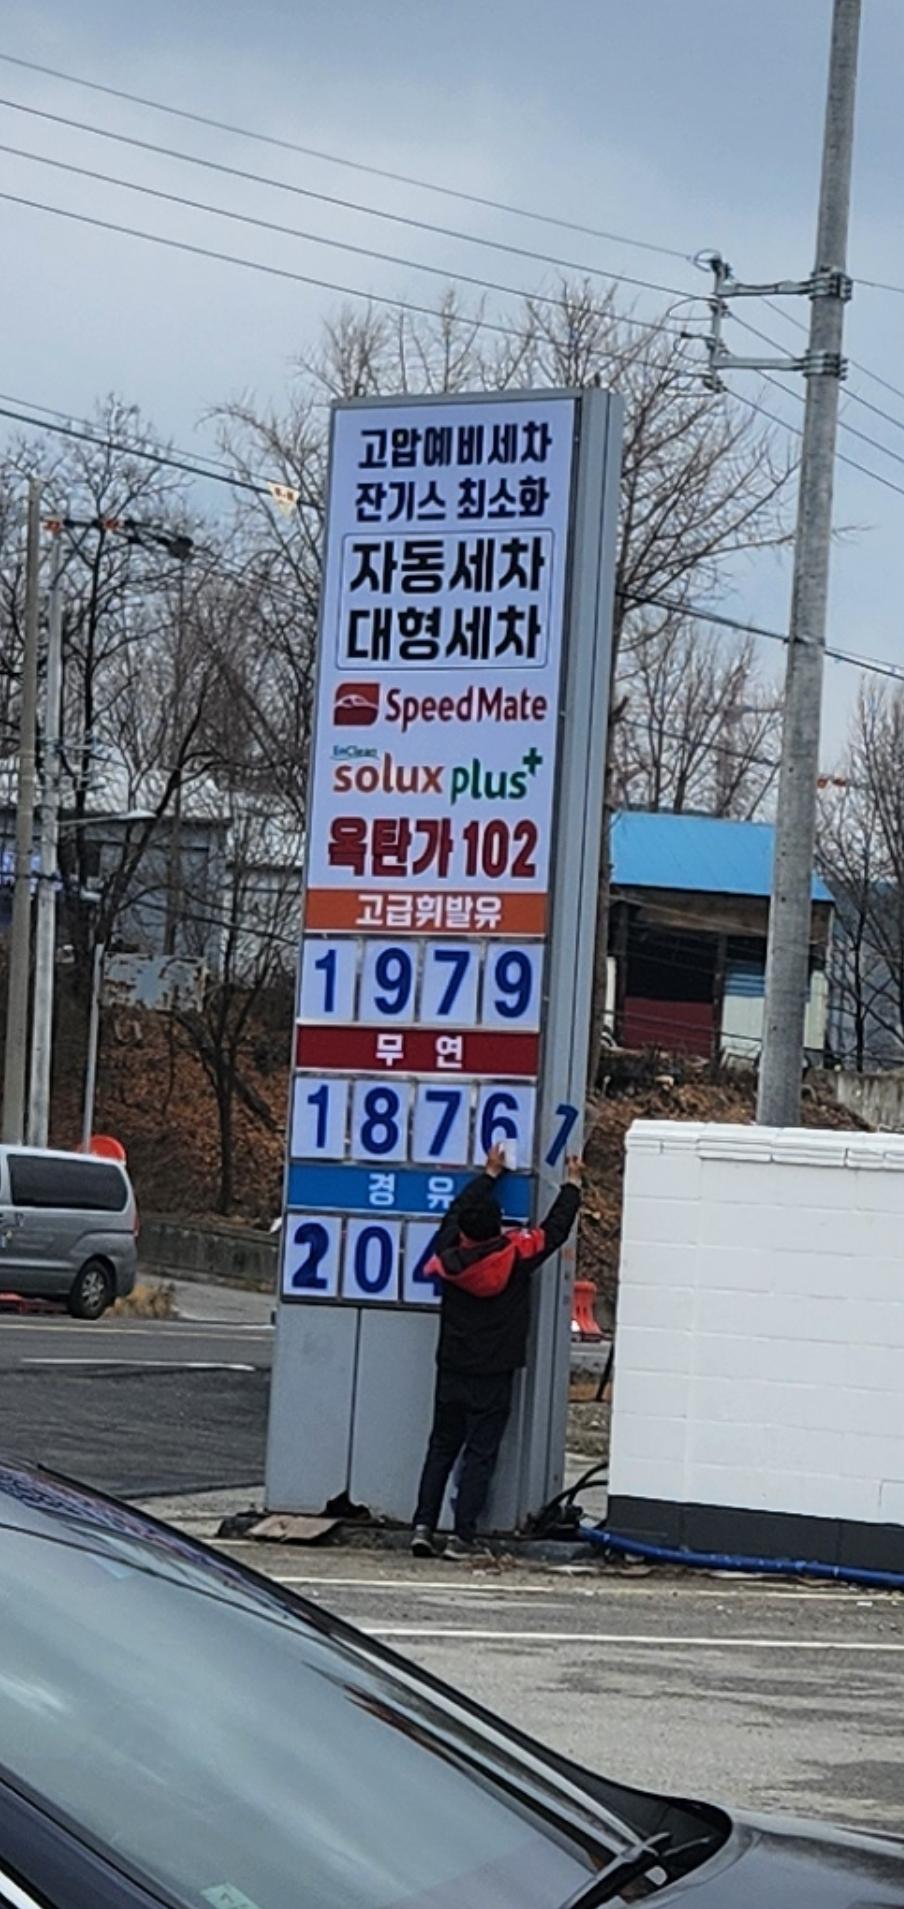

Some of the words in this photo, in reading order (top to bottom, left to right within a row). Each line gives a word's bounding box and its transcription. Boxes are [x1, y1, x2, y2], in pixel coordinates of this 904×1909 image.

[358, 420, 552, 469] 고압예비세차
[355, 480, 446, 522] 잔기스
[457, 475, 549, 519] 최소화
[350, 537, 545, 594] 자동세차
[346, 605, 541, 661] 대형세차
[385, 685, 548, 733] SpeedMate
[333, 752, 445, 794] solux
[328, 817, 453, 878] 옥탄가
[463, 820, 538, 878] 102
[355, 894, 501, 928] 고급휘발유
[315, 947, 532, 1018] 1979
[307, 1084, 518, 1156] 1876
[292, 1222, 442, 1296] 204
